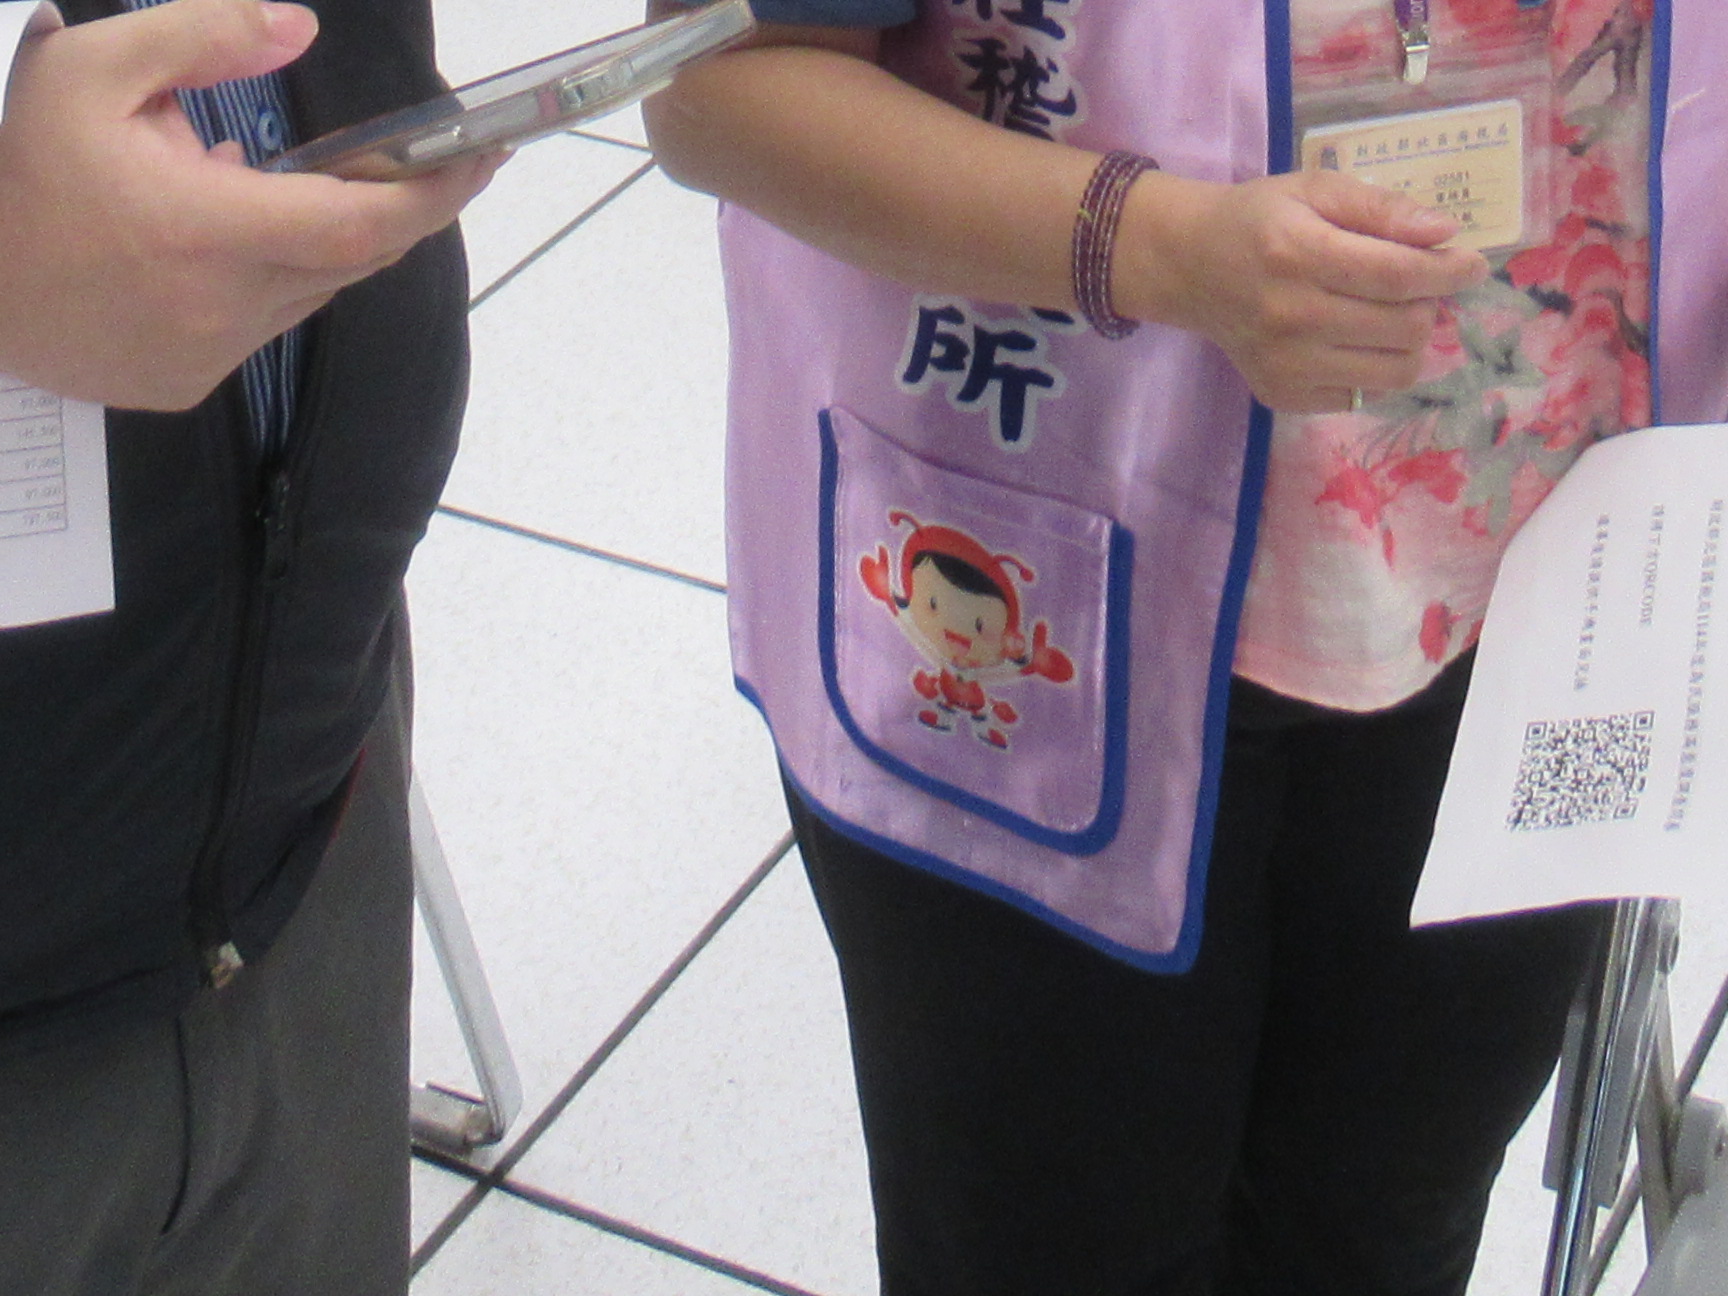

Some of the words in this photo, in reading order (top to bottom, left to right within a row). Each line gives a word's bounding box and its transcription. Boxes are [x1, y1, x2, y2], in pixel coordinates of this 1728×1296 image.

[1357, 121, 1510, 158] 財政部北區國稅局
